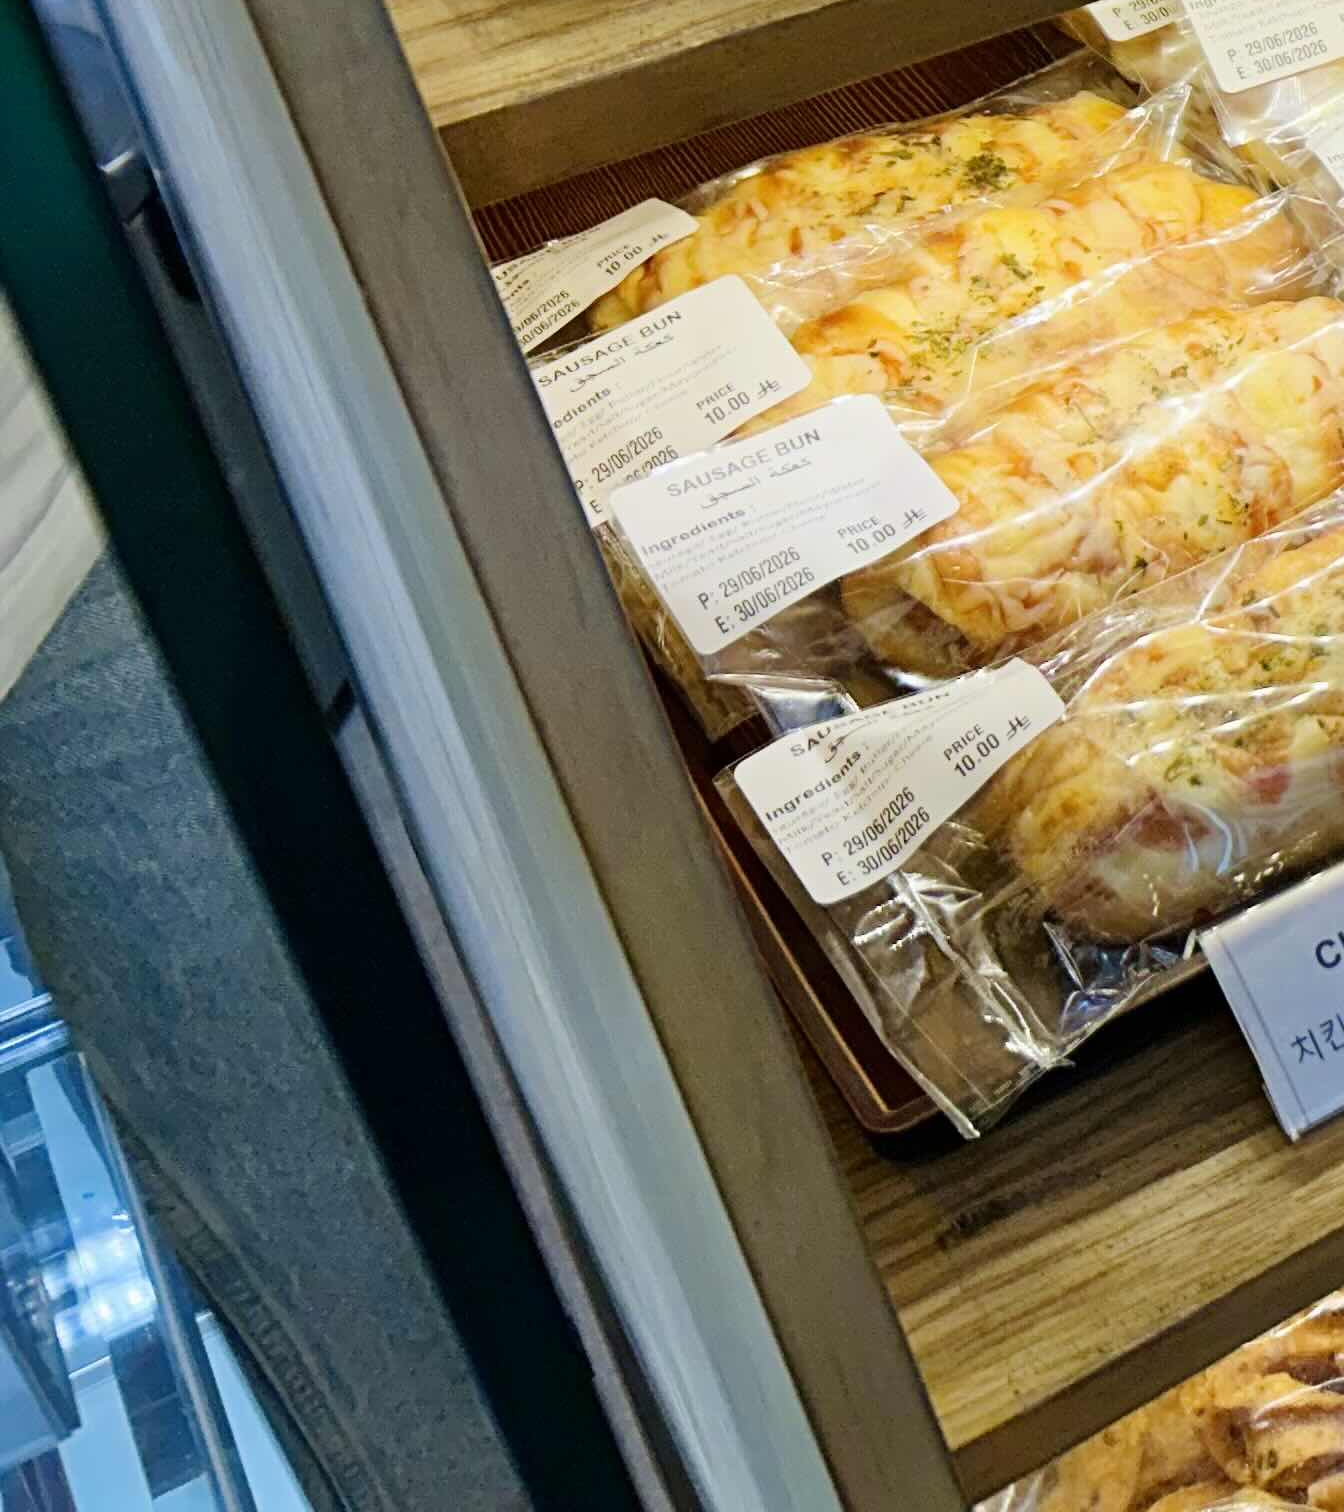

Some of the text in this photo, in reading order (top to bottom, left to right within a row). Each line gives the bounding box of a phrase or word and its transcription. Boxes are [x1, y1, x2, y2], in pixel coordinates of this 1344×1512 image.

[1247, 21, 1320, 56] 29/06/2026
[1256, 40, 1329, 74] 30/06/2026
[537, 309, 683, 389] SAUSAGE BUN
[695, 381, 737, 412] PRICE
[702, 389, 751, 426] 10.00
[591, 425, 666, 485] 29/06/2026
[665, 428, 822, 499] SAUSAGE BUN
[836, 514, 881, 539] PRICE
[845, 523, 897, 556] 10.00
[718, 545, 802, 598] 29/06/2026
[733, 566, 816, 621] 30/06/2026
[942, 722, 985, 762] PRICE
[953, 734, 1001, 779] 10.00
[842, 785, 917, 856] 29/06/2026
[860, 805, 932, 876] 30/06/2026
